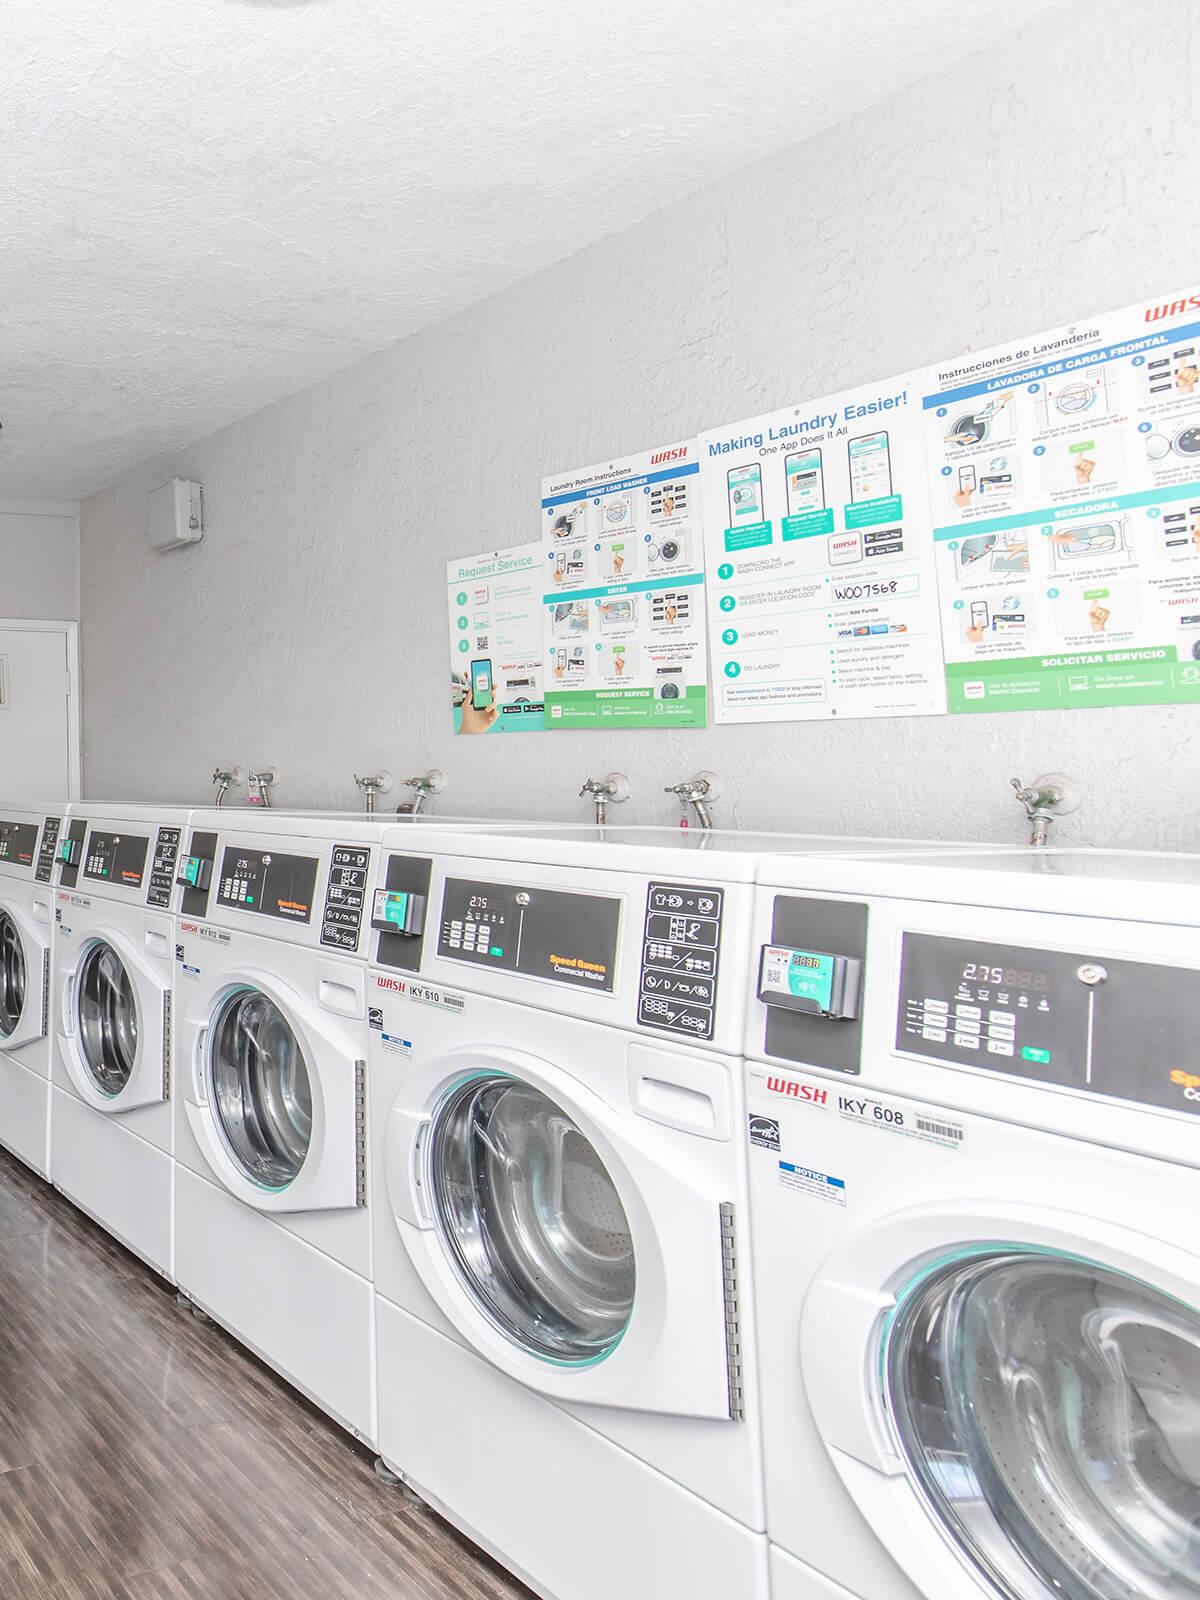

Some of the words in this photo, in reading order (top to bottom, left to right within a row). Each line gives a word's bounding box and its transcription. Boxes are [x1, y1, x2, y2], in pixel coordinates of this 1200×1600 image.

[938, 354, 1013, 382] Instrucciones
[1015, 348, 1030, 360] de
[1033, 328, 1100, 354] Lavandería
[987, 370, 1045, 391] LAVADORA
[1048, 364, 1064, 374] DE
[1065, 352, 1107, 370] CARGA
[1110, 336, 1169, 357] FRONTAL
[708, 432, 763, 457] Making
[769, 413, 837, 440] Laundry
[844, 390, 909, 420] Easier!
[759, 446, 777, 457] One
[780, 441, 798, 453] App
[800, 435, 824, 447] Does
[827, 431, 834, 440] It
[836, 427, 848, 438] All
[651, 447, 688, 465] WASH
[550, 481, 574, 492] Laundry
[575, 477, 593, 487] Room
[594, 467, 632, 481] Instructions
[586, 486, 606, 496] FRONT
[607, 482, 621, 492] LOAD
[621, 477, 648, 489] WASHER
[1054, 501, 1119, 518] SECADORA
[832, 539, 857, 549] WASH
[458, 562, 496, 579] Request
[498, 555, 533, 572] Service
[722, 566, 727, 575] 1
[736, 559, 769, 569] DOWNLOAD
[754, 562, 782, 571] CONNECT
[768, 594, 797, 602] LOCATION
[773, 587, 801, 595] LAUNDRY
[723, 598, 731, 608] 2
[726, 631, 734, 641] 3
[757, 628, 777, 636] MONEY
[1041, 651, 1103, 667] SOLICITAR
[1106, 649, 1166, 663] SERVICIO
[728, 663, 736, 674] 4
[549, 954, 576, 967] Speed
[577, 959, 607, 973] Queen
[377, 976, 406, 992] WASH
[409, 986, 423, 998] IKY
[425, 990, 440, 1002] 610
[767, 1076, 828, 1105] WASH
[838, 1096, 867, 1115] IKY
[873, 1106, 905, 1125] 608
[793, 1166, 828, 1184] NOTICE
